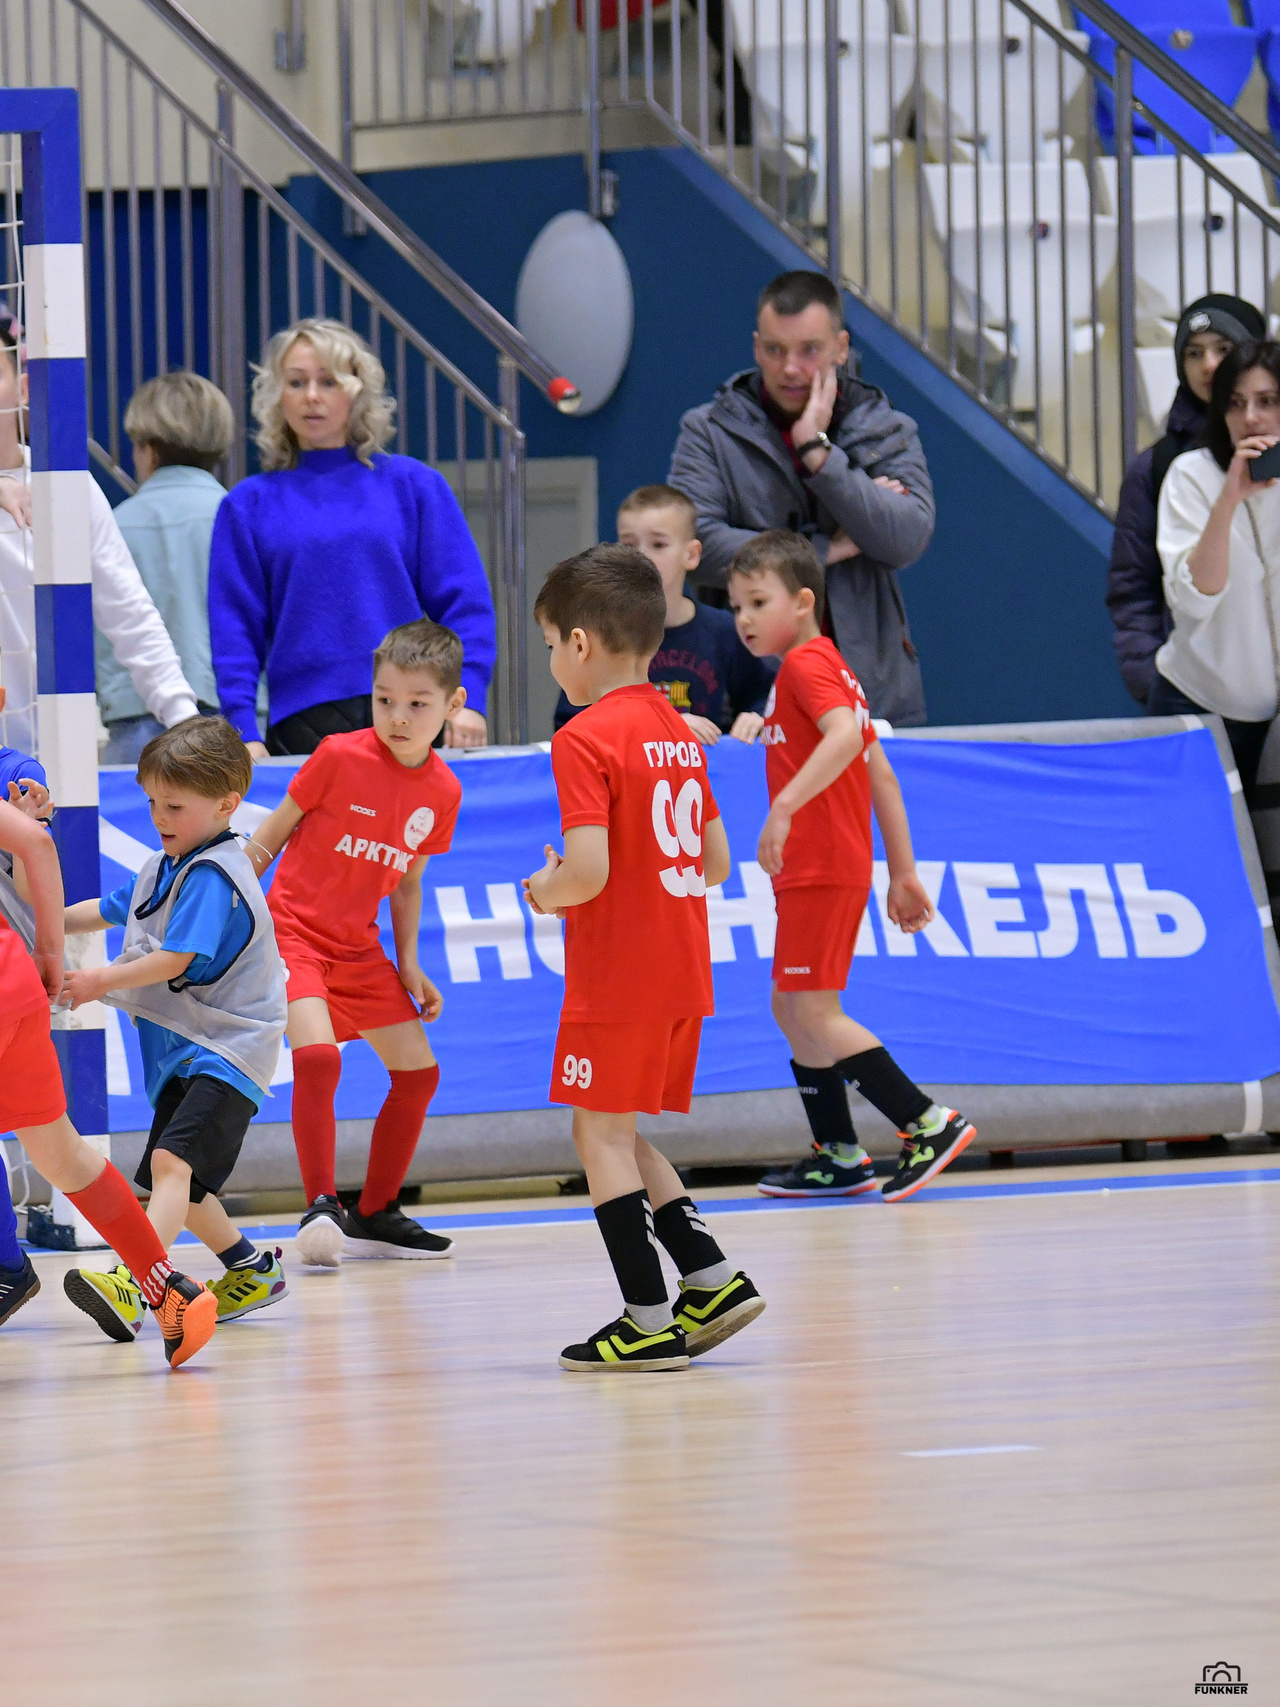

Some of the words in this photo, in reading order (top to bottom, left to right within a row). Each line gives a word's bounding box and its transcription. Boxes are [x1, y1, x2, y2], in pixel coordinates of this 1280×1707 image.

[643, 741, 702, 768] ГУРОВ
[434, 860, 1207, 984] ННКЕЛЬ
[561, 1054, 593, 1089] 99
